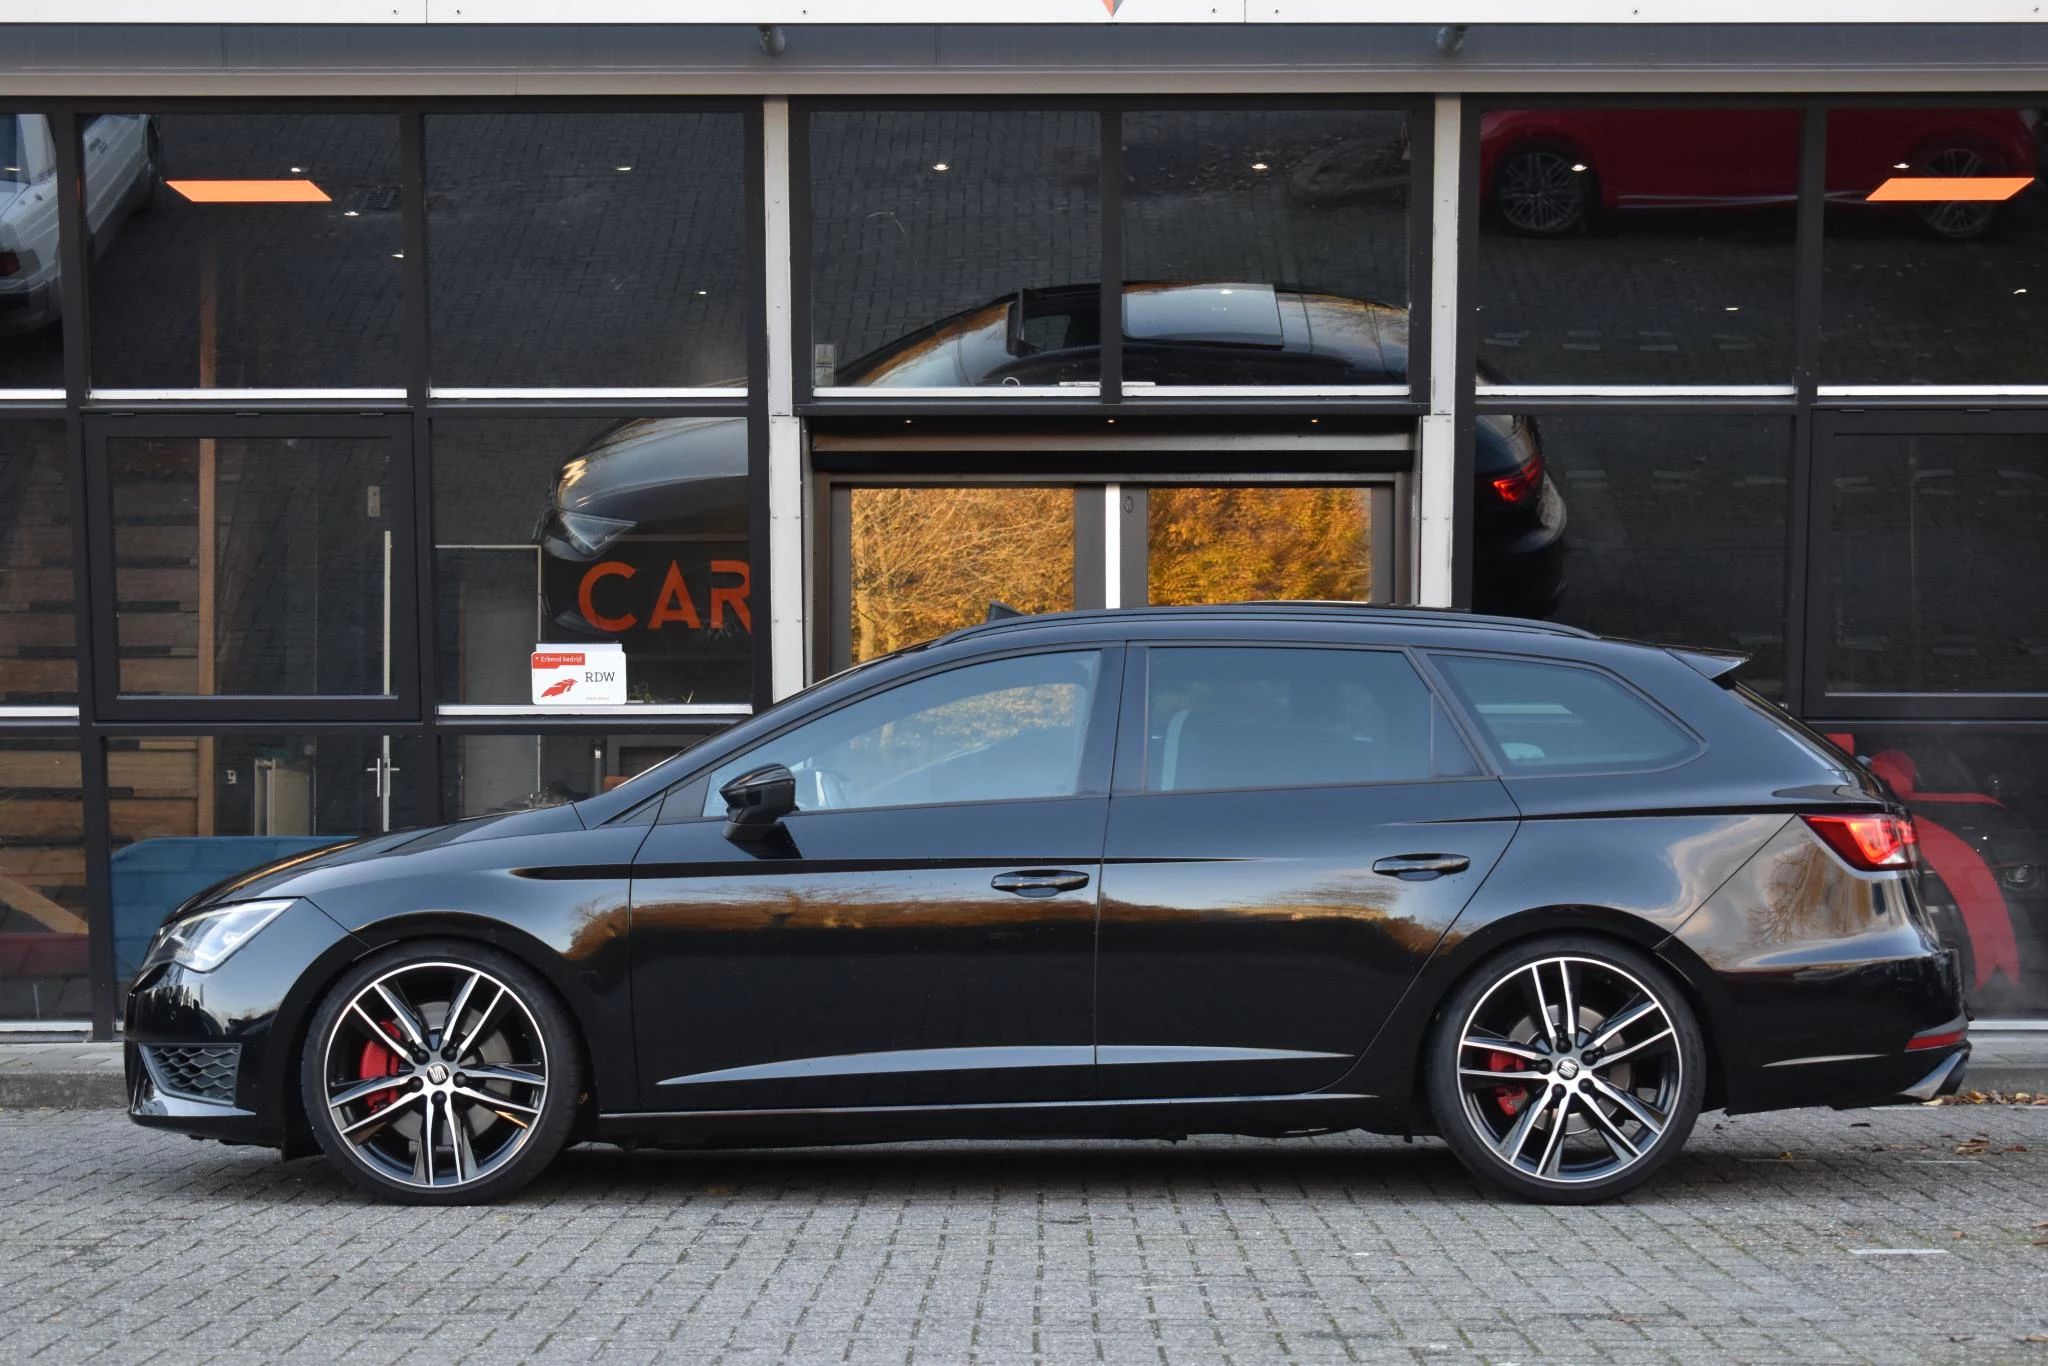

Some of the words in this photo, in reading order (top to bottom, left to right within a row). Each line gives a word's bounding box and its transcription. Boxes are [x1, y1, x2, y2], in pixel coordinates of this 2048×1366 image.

[578, 559, 752, 635] CAR
[562, 656, 582, 664] bedrijf
[585, 671, 616, 683] RDW
